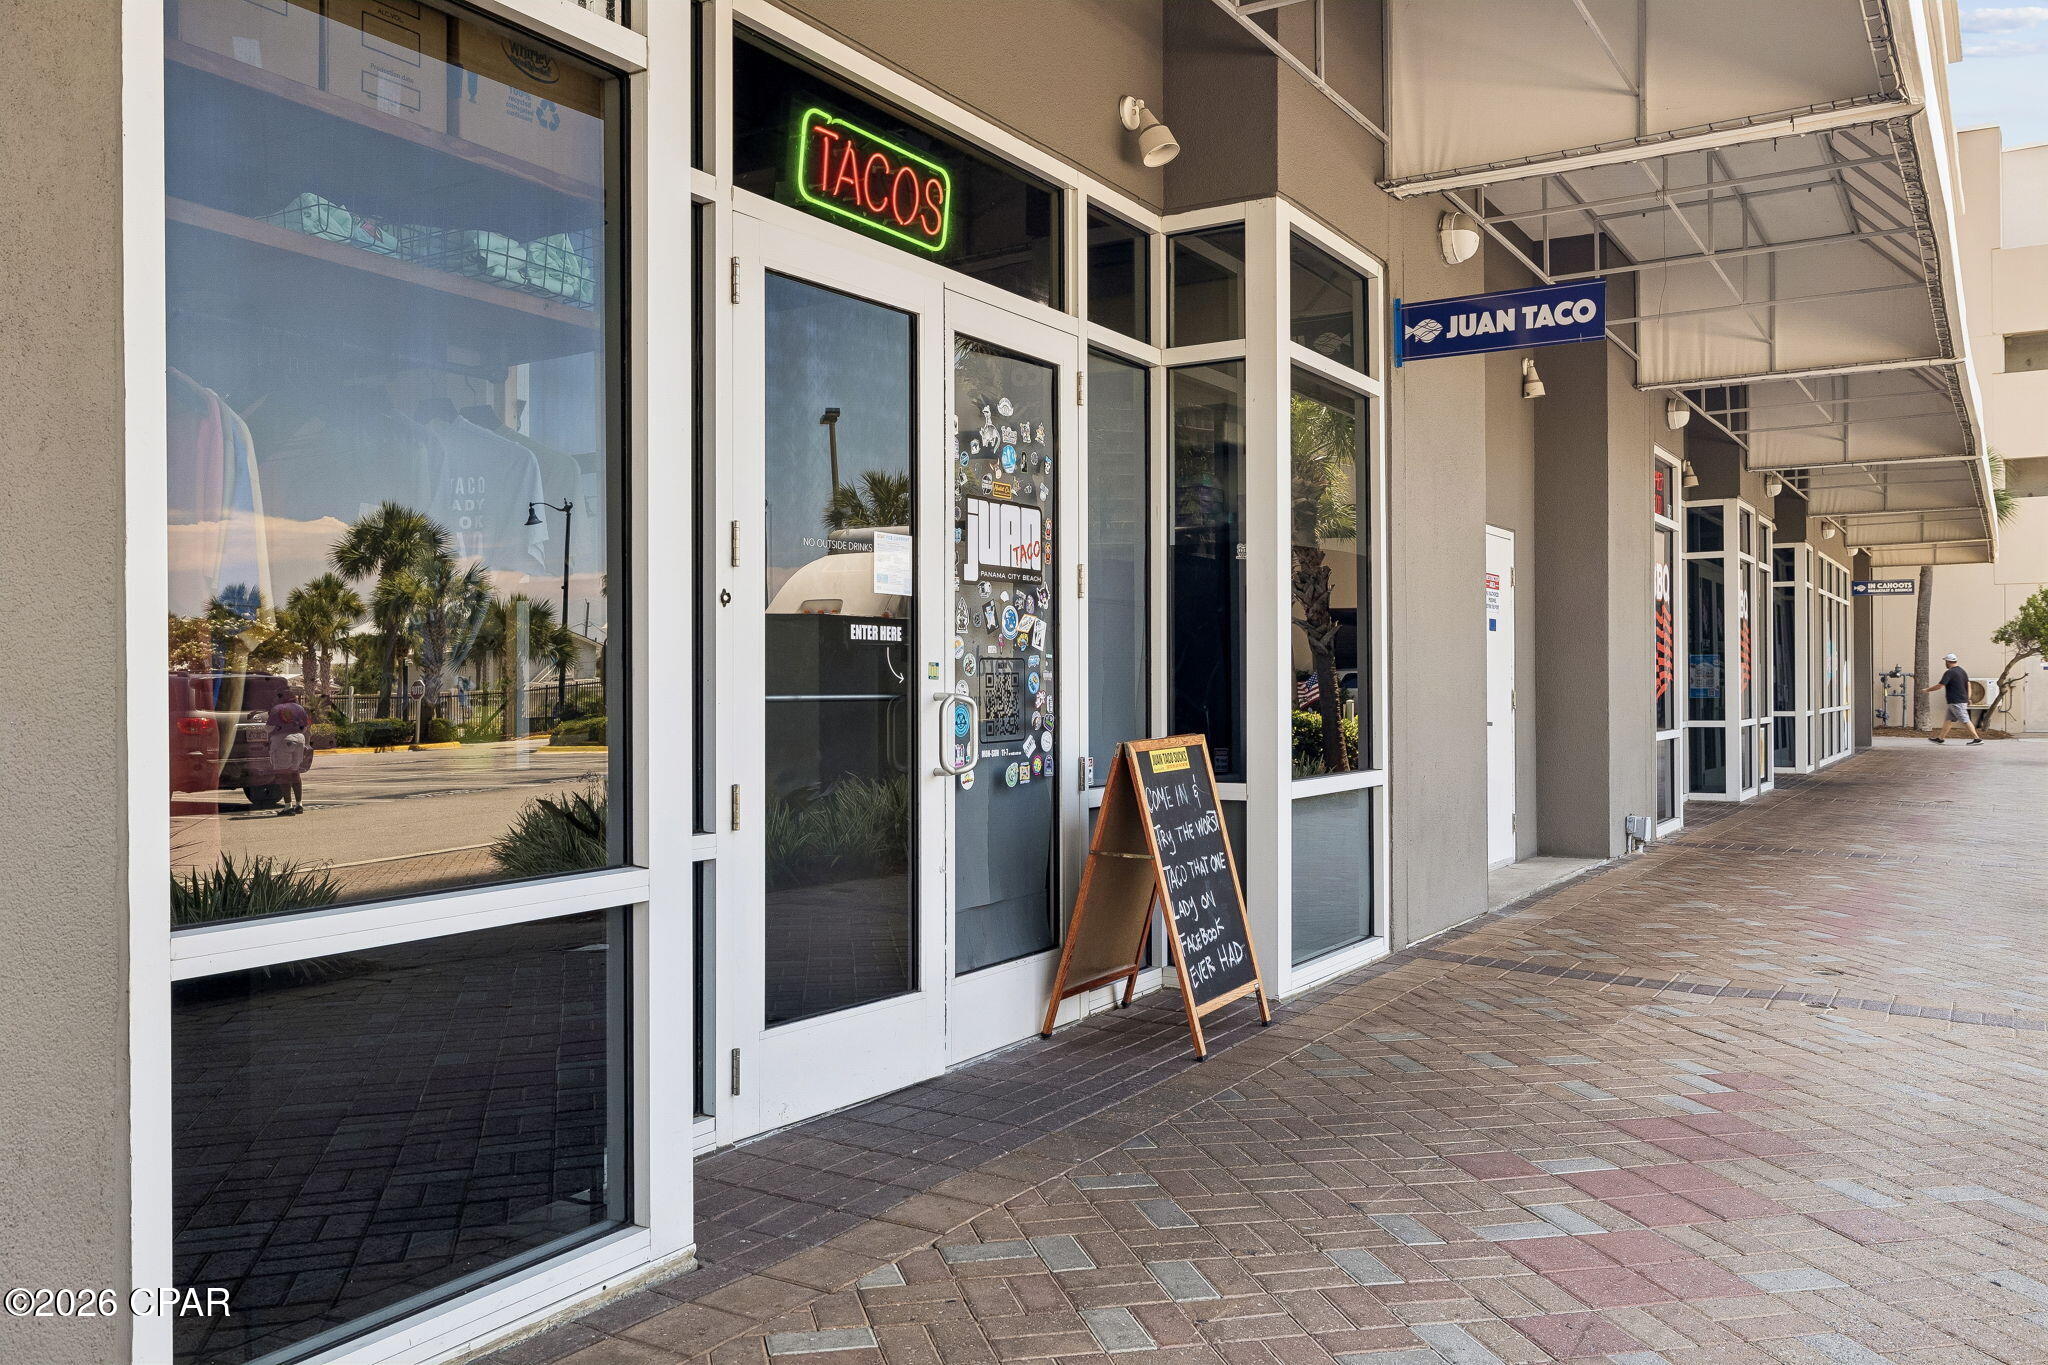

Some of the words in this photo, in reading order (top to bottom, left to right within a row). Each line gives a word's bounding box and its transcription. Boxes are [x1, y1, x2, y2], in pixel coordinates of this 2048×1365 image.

[370, 63, 401, 79] Production
[814, 125, 944, 236] TACOS
[1446, 307, 1516, 339] JUAN
[1522, 298, 1597, 330] TACO
[803, 537, 815, 548] NO
[816, 539, 847, 551] OUTSIDE
[848, 541, 874, 553] DRINKS
[1012, 540, 1041, 567] TACO
[980, 569, 1007, 580] PANAMA
[1007, 572, 1021, 581] CITY
[1022, 573, 1042, 583] BEACH
[1654, 560, 1671, 604] BQ
[1876, 582, 1913, 590] CAHOOTS
[850, 624, 879, 641] ENTER
[879, 626, 902, 642] HERE
[1163, 751, 1175, 765] TACO
[1145, 785, 1174, 813] COME
[1175, 783, 1189, 807] IN
[1153, 824, 1177, 855] TRY
[1174, 821, 1195, 843] THE
[1195, 810, 1221, 837] WORST
[1163, 864, 1188, 893] TACO
[1187, 855, 1209, 879] THAT
[1210, 852, 1226, 873] ONE
[1172, 896, 1199, 922] LADY
[1200, 890, 1217, 909] ON
[1178, 917, 1225, 958] FACEBOOK
[1189, 955, 1217, 989] EVER
[1216, 940, 1245, 972] HAD
